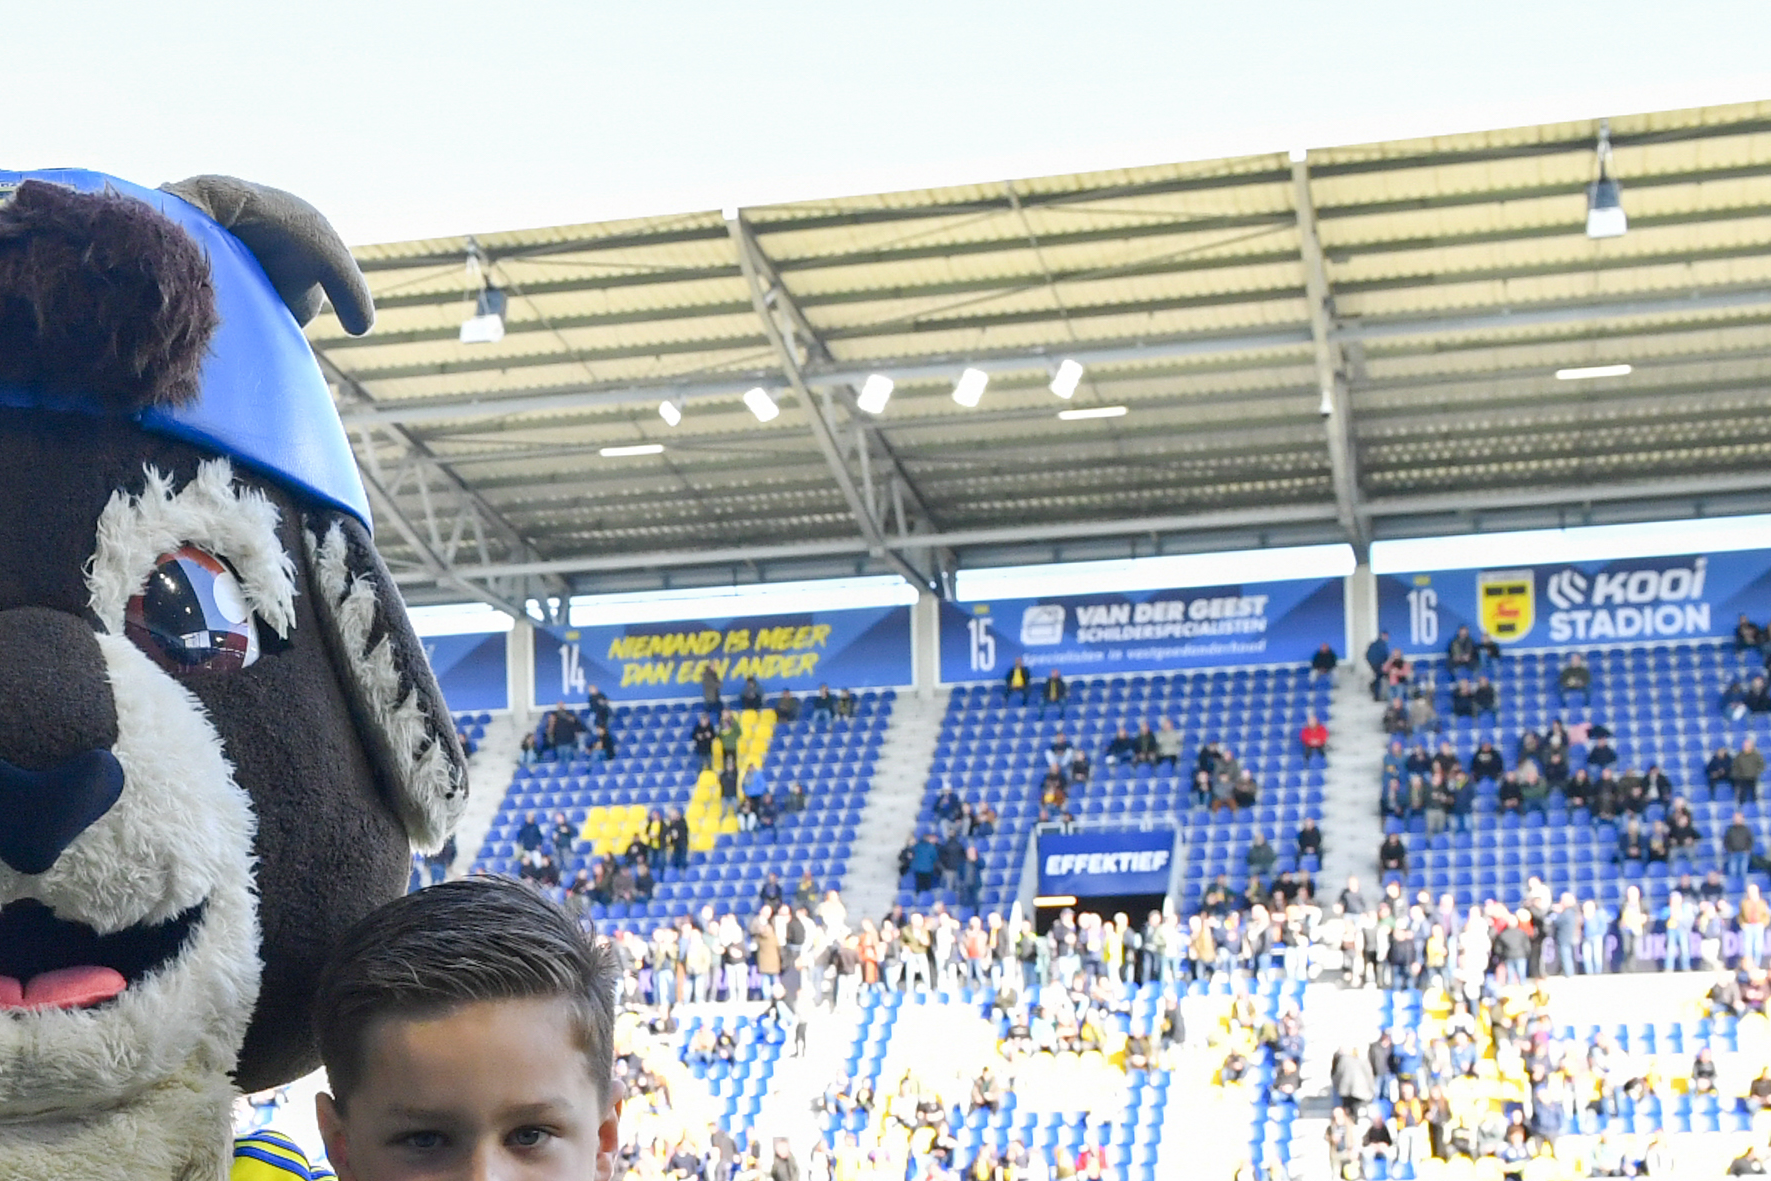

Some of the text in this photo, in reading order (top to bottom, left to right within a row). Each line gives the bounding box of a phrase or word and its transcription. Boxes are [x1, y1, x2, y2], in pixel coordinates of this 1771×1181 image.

[1076, 595, 1269, 626] VAN DER GEEST
[1406, 588, 1438, 646] 16
[1549, 603, 1711, 642] STADION
[608, 624, 832, 660] NIEMAND IS MEER
[968, 617, 996, 672] 15
[559, 643, 586, 695] 14
[620, 660, 675, 688] DAN
[731, 652, 820, 681] ANDER
[1045, 850, 1169, 875] EFFEKTIEF
